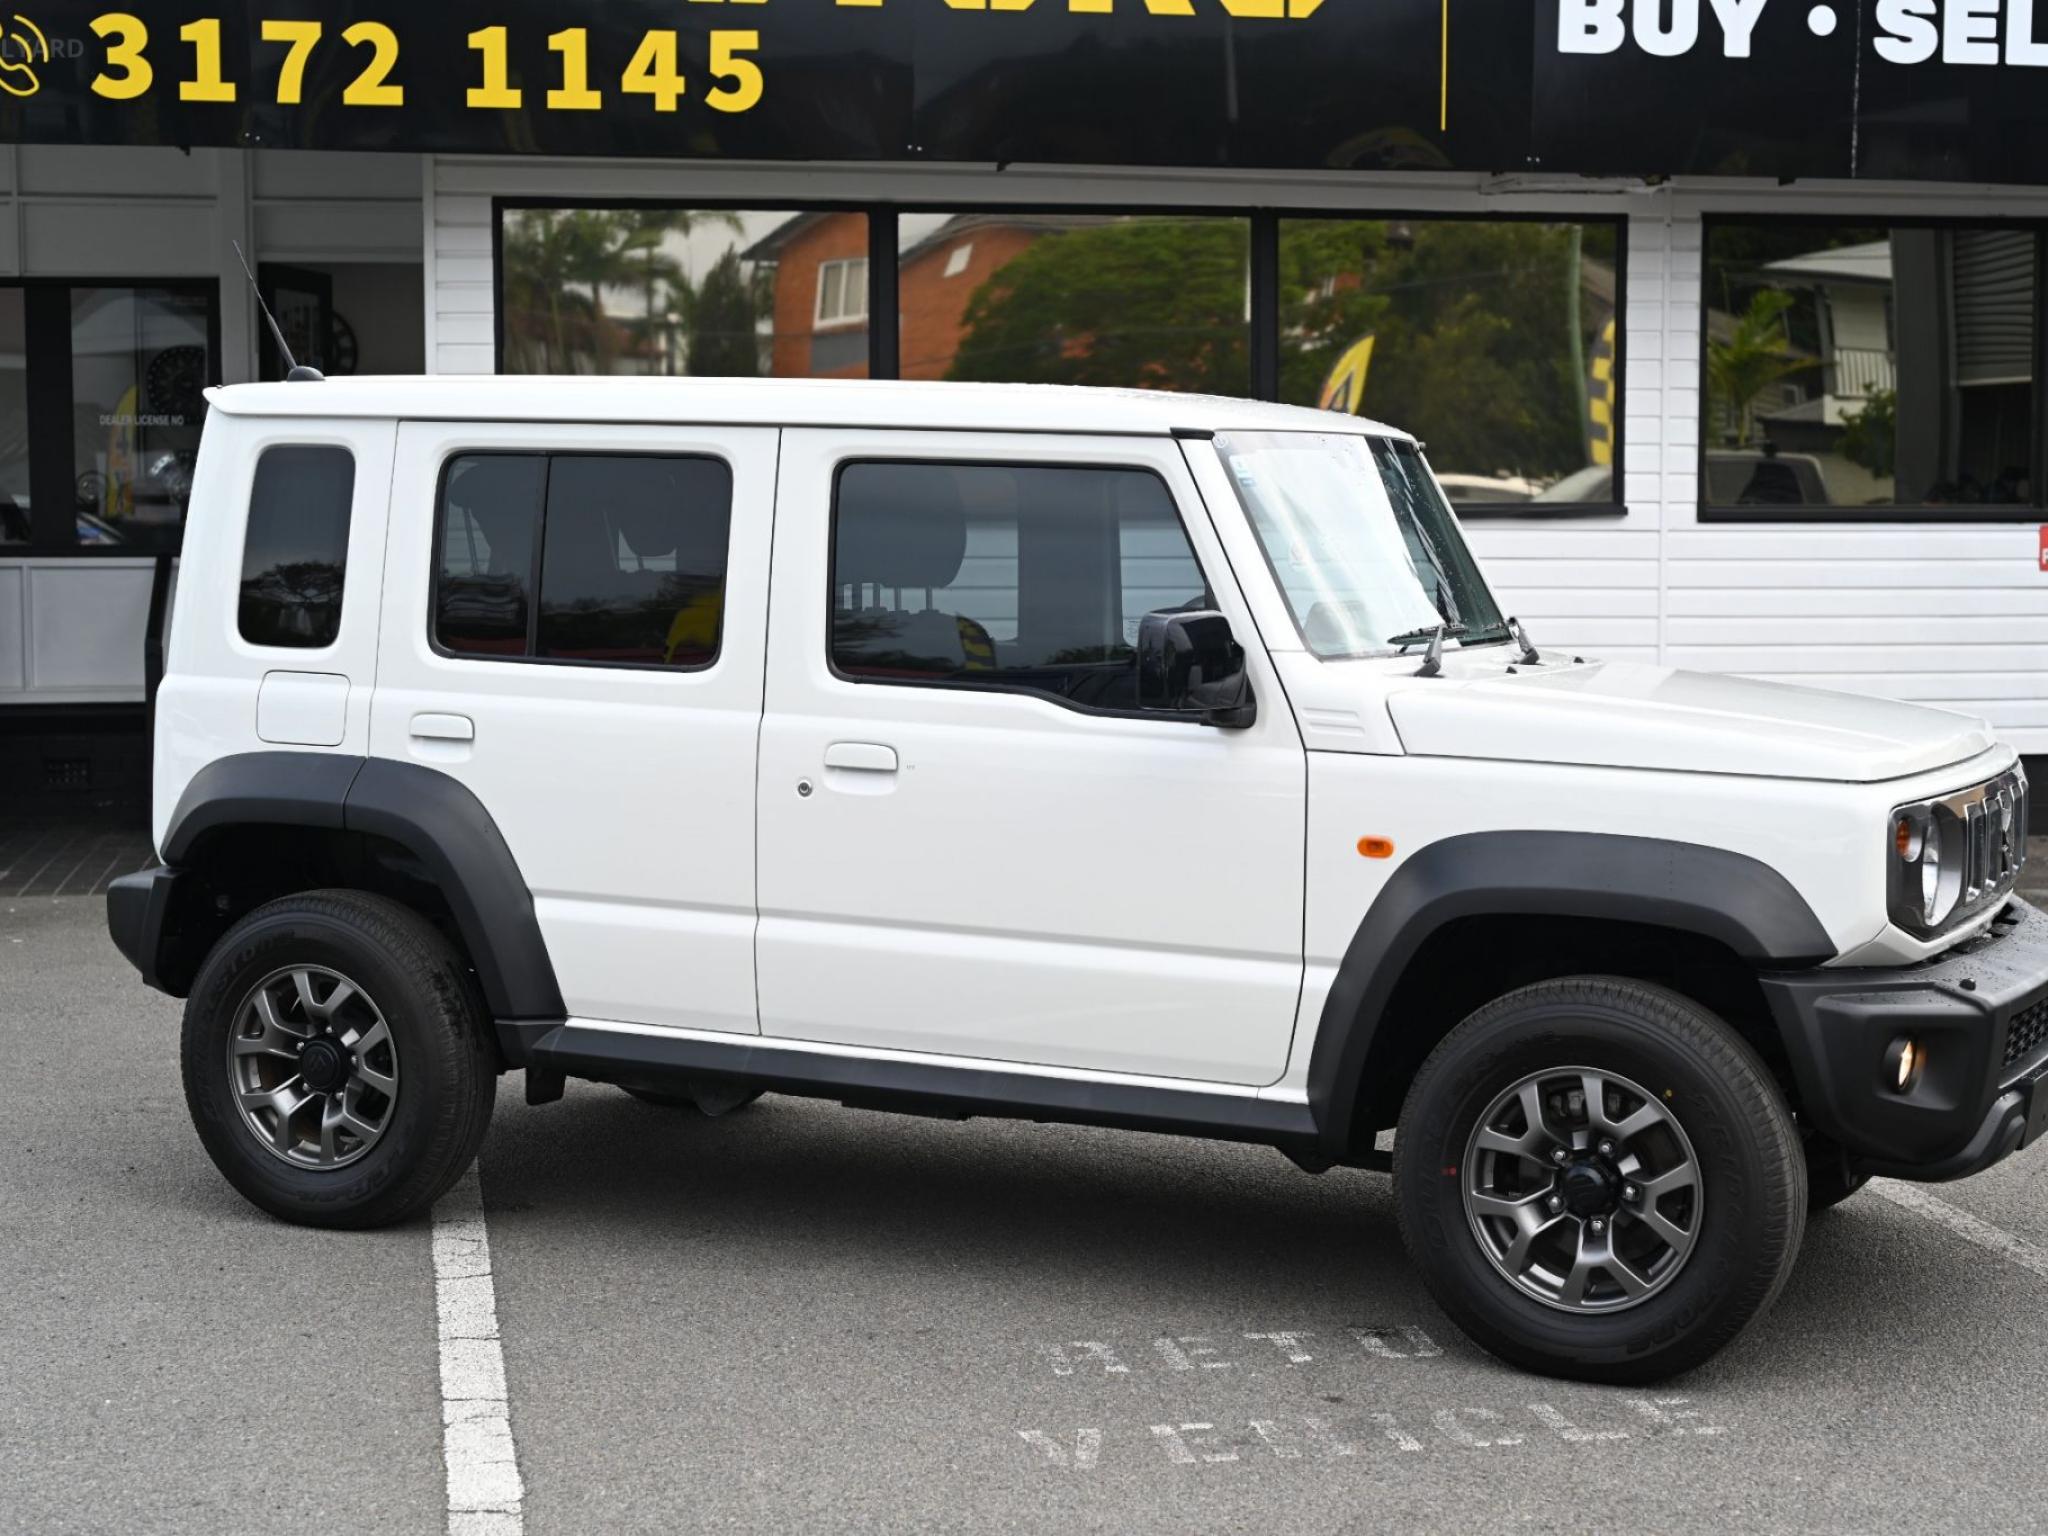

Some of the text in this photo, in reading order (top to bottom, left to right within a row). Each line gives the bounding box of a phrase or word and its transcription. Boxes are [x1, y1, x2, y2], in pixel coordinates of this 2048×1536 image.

[1557, 0, 1768, 58] BUY
[90, 13, 764, 113] 3172 1145
[99, 414, 132, 426] DEALER
[135, 414, 169, 426] LICENSE
[1016, 1399, 1728, 1470] VEHICLE
